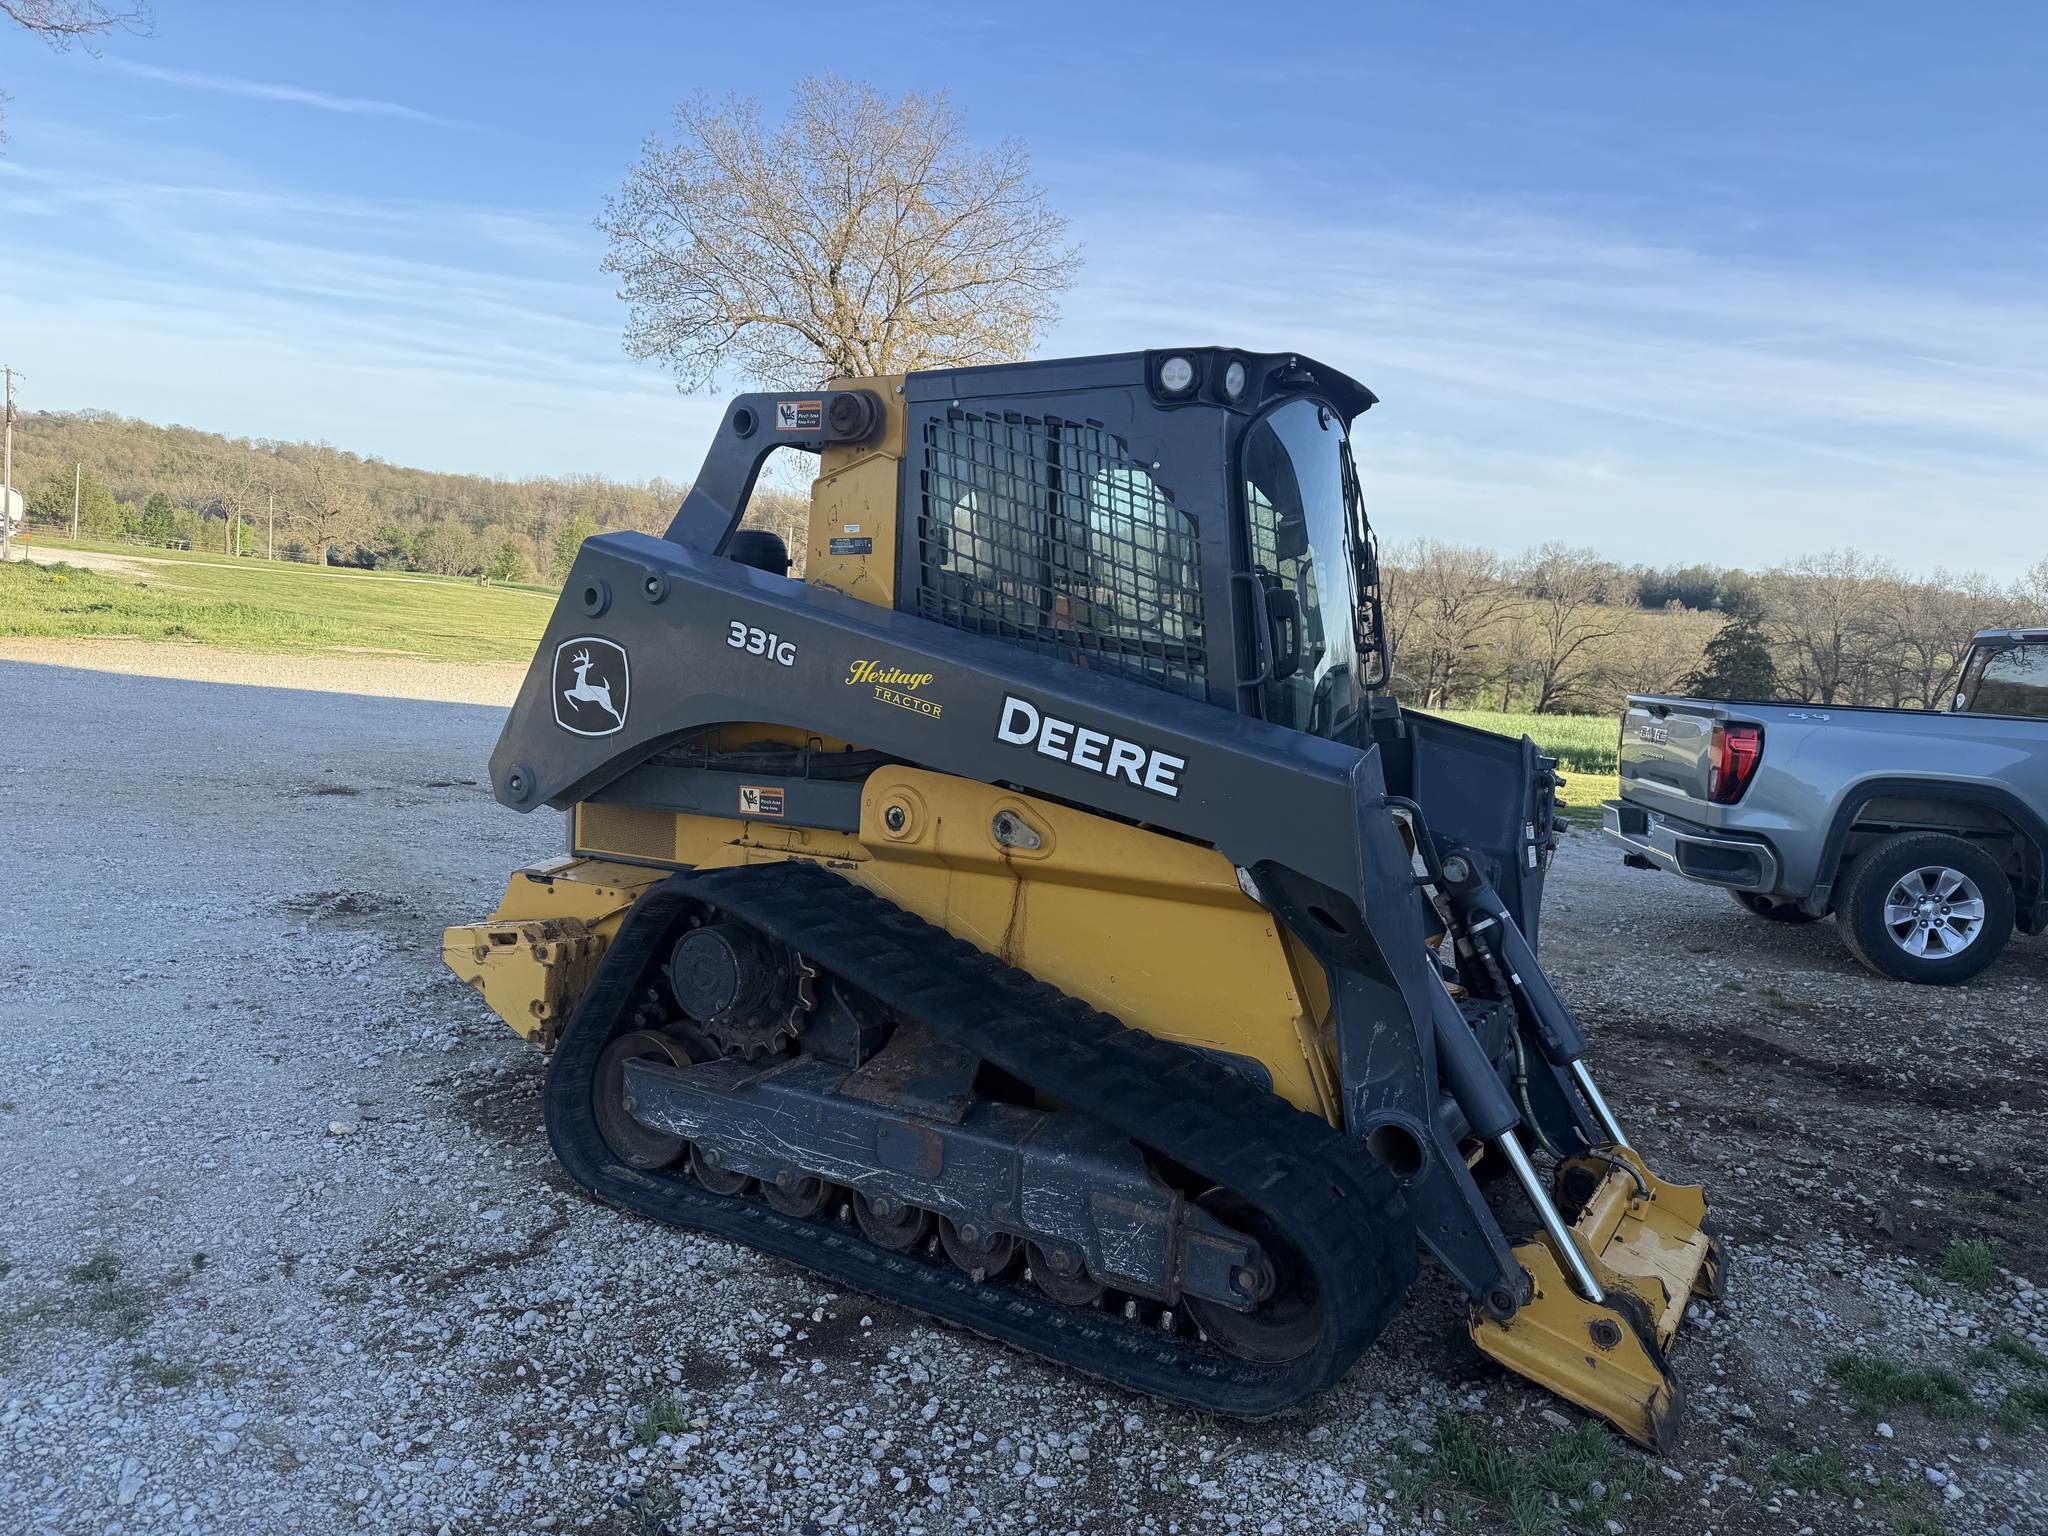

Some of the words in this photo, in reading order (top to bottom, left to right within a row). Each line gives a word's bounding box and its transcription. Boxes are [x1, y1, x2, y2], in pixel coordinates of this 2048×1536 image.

[727, 621, 797, 666] 331G
[845, 660, 934, 690] Heritage
[875, 688, 942, 716] TRACTOR
[998, 696, 1185, 797] DEERE
